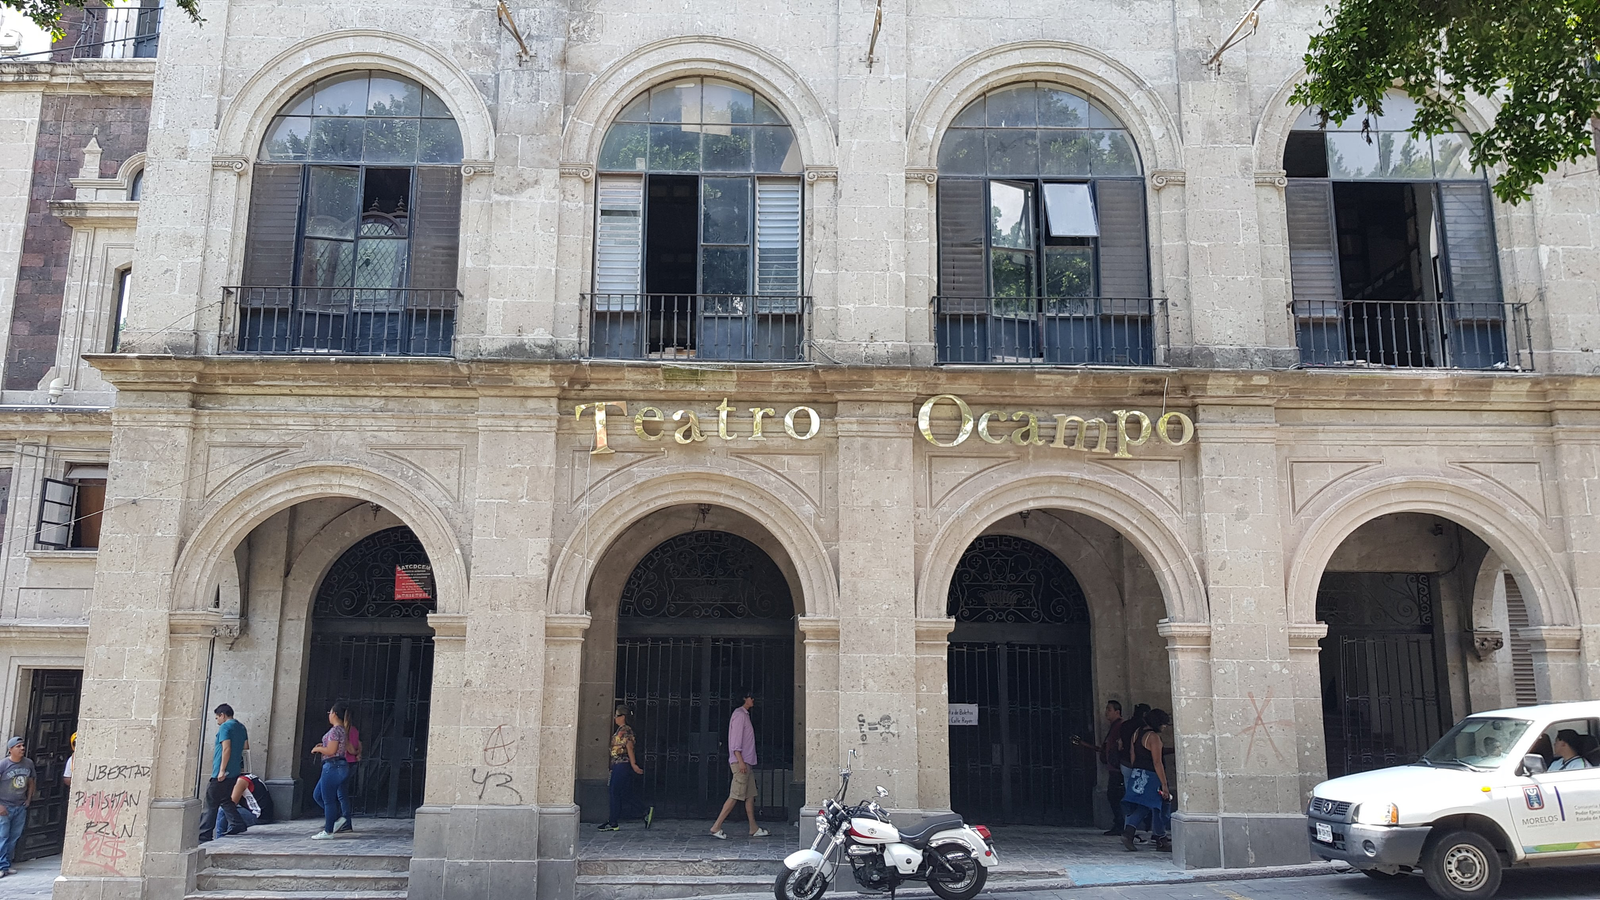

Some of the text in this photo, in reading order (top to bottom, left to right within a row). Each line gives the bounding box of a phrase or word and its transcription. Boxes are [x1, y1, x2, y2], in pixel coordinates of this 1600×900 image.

[575, 394, 1195, 458] Teatro Ocampo
[1522, 815, 1558, 825] MORELOS
